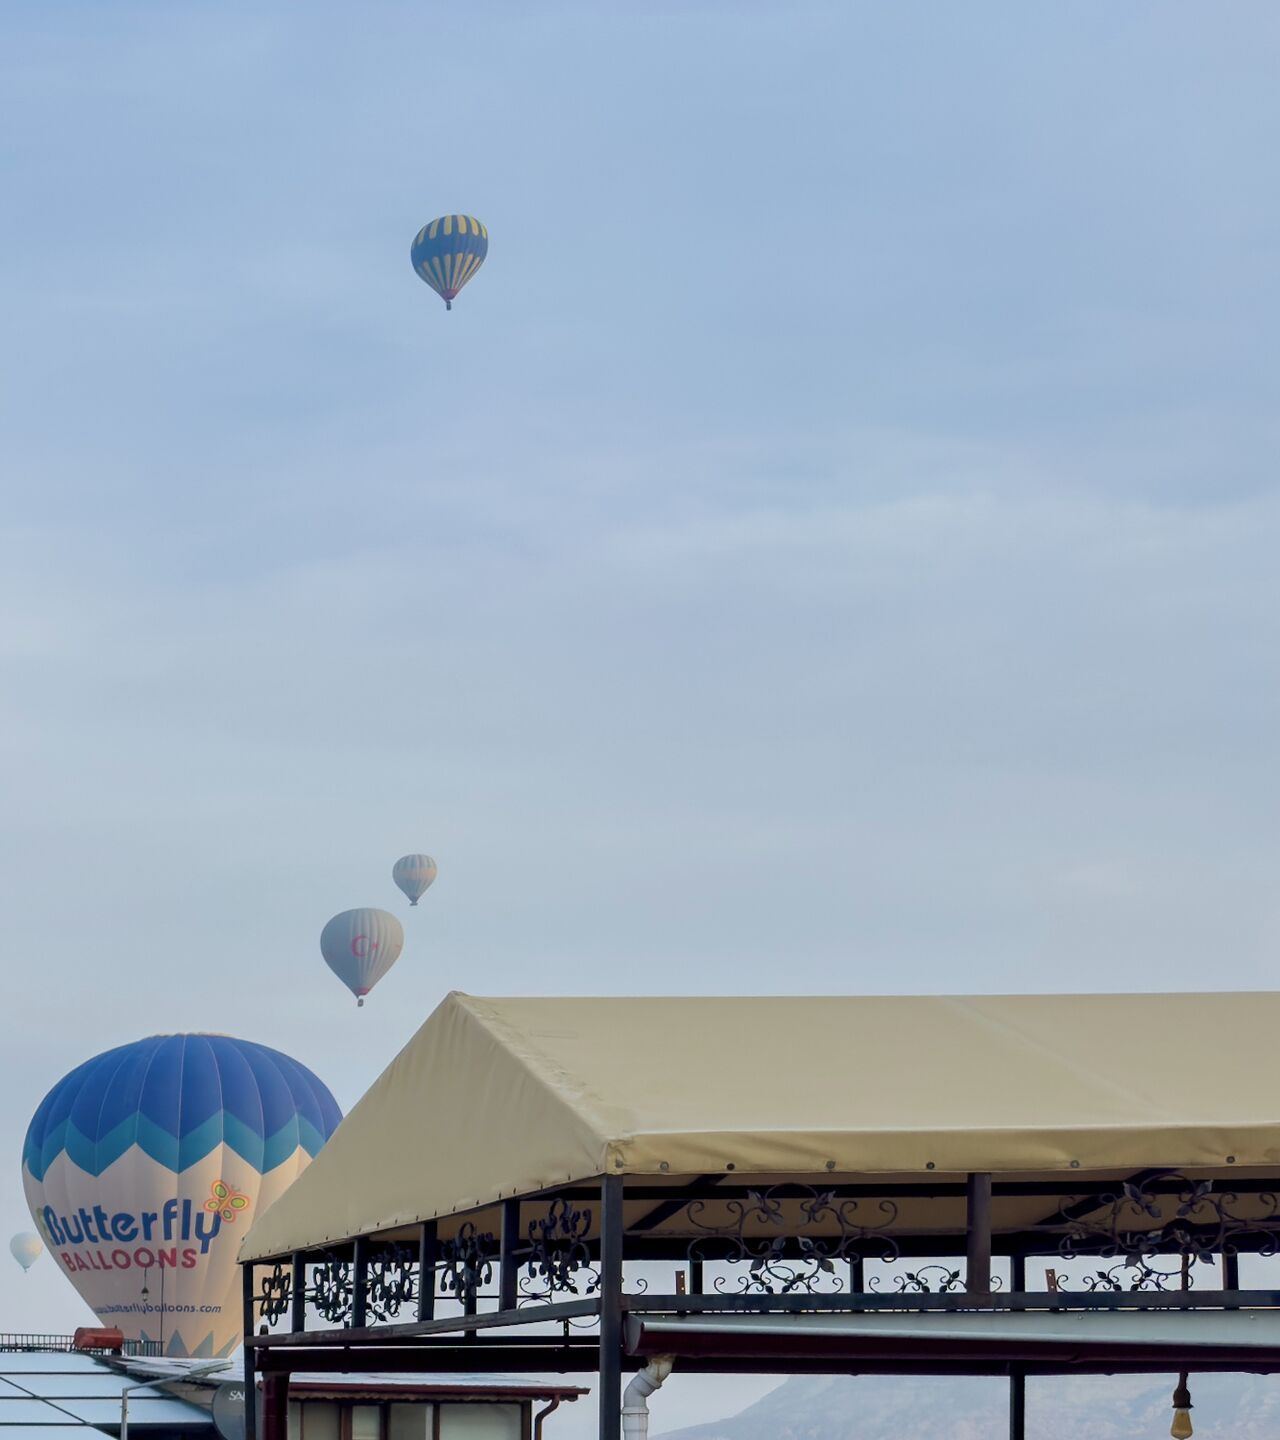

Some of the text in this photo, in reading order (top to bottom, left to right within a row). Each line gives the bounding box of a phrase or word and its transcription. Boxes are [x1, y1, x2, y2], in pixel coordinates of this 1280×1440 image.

[42, 1197, 223, 1255] Butterfly
[60, 1246, 198, 1273] BALLOONS
[228, 1389, 245, 1402] SA
